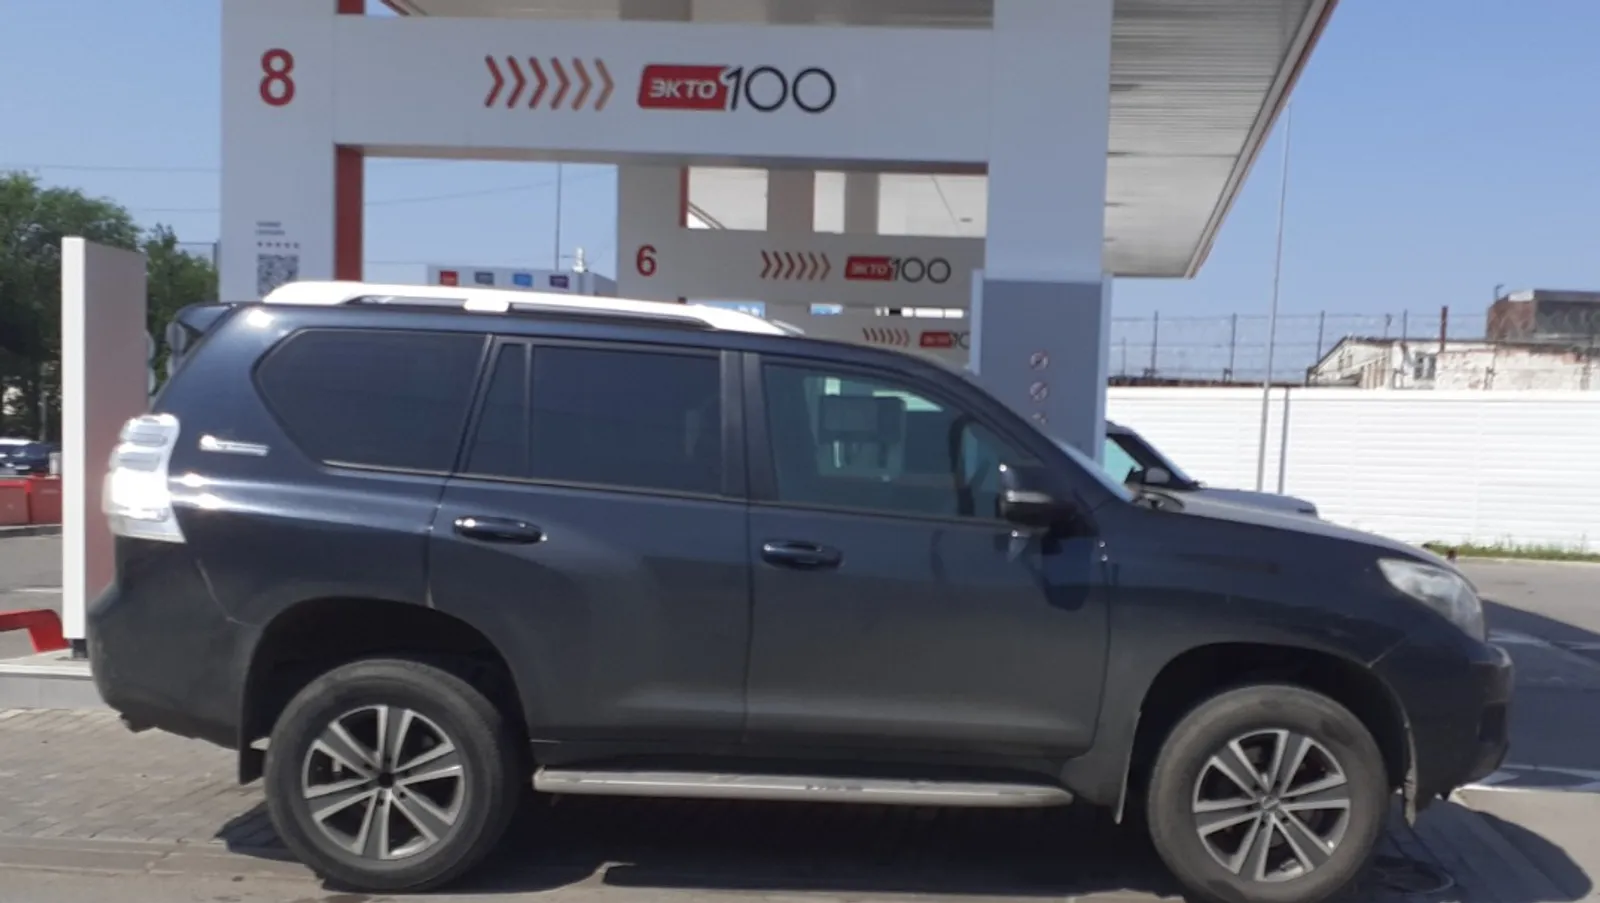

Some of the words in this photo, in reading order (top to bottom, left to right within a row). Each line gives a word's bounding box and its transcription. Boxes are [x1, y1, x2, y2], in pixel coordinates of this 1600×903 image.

[260, 48, 295, 107] 8
[649, 78, 718, 99] ЭКТО
[725, 65, 837, 113] 100
[636, 244, 657, 277] 6
[892, 257, 951, 284] 100
